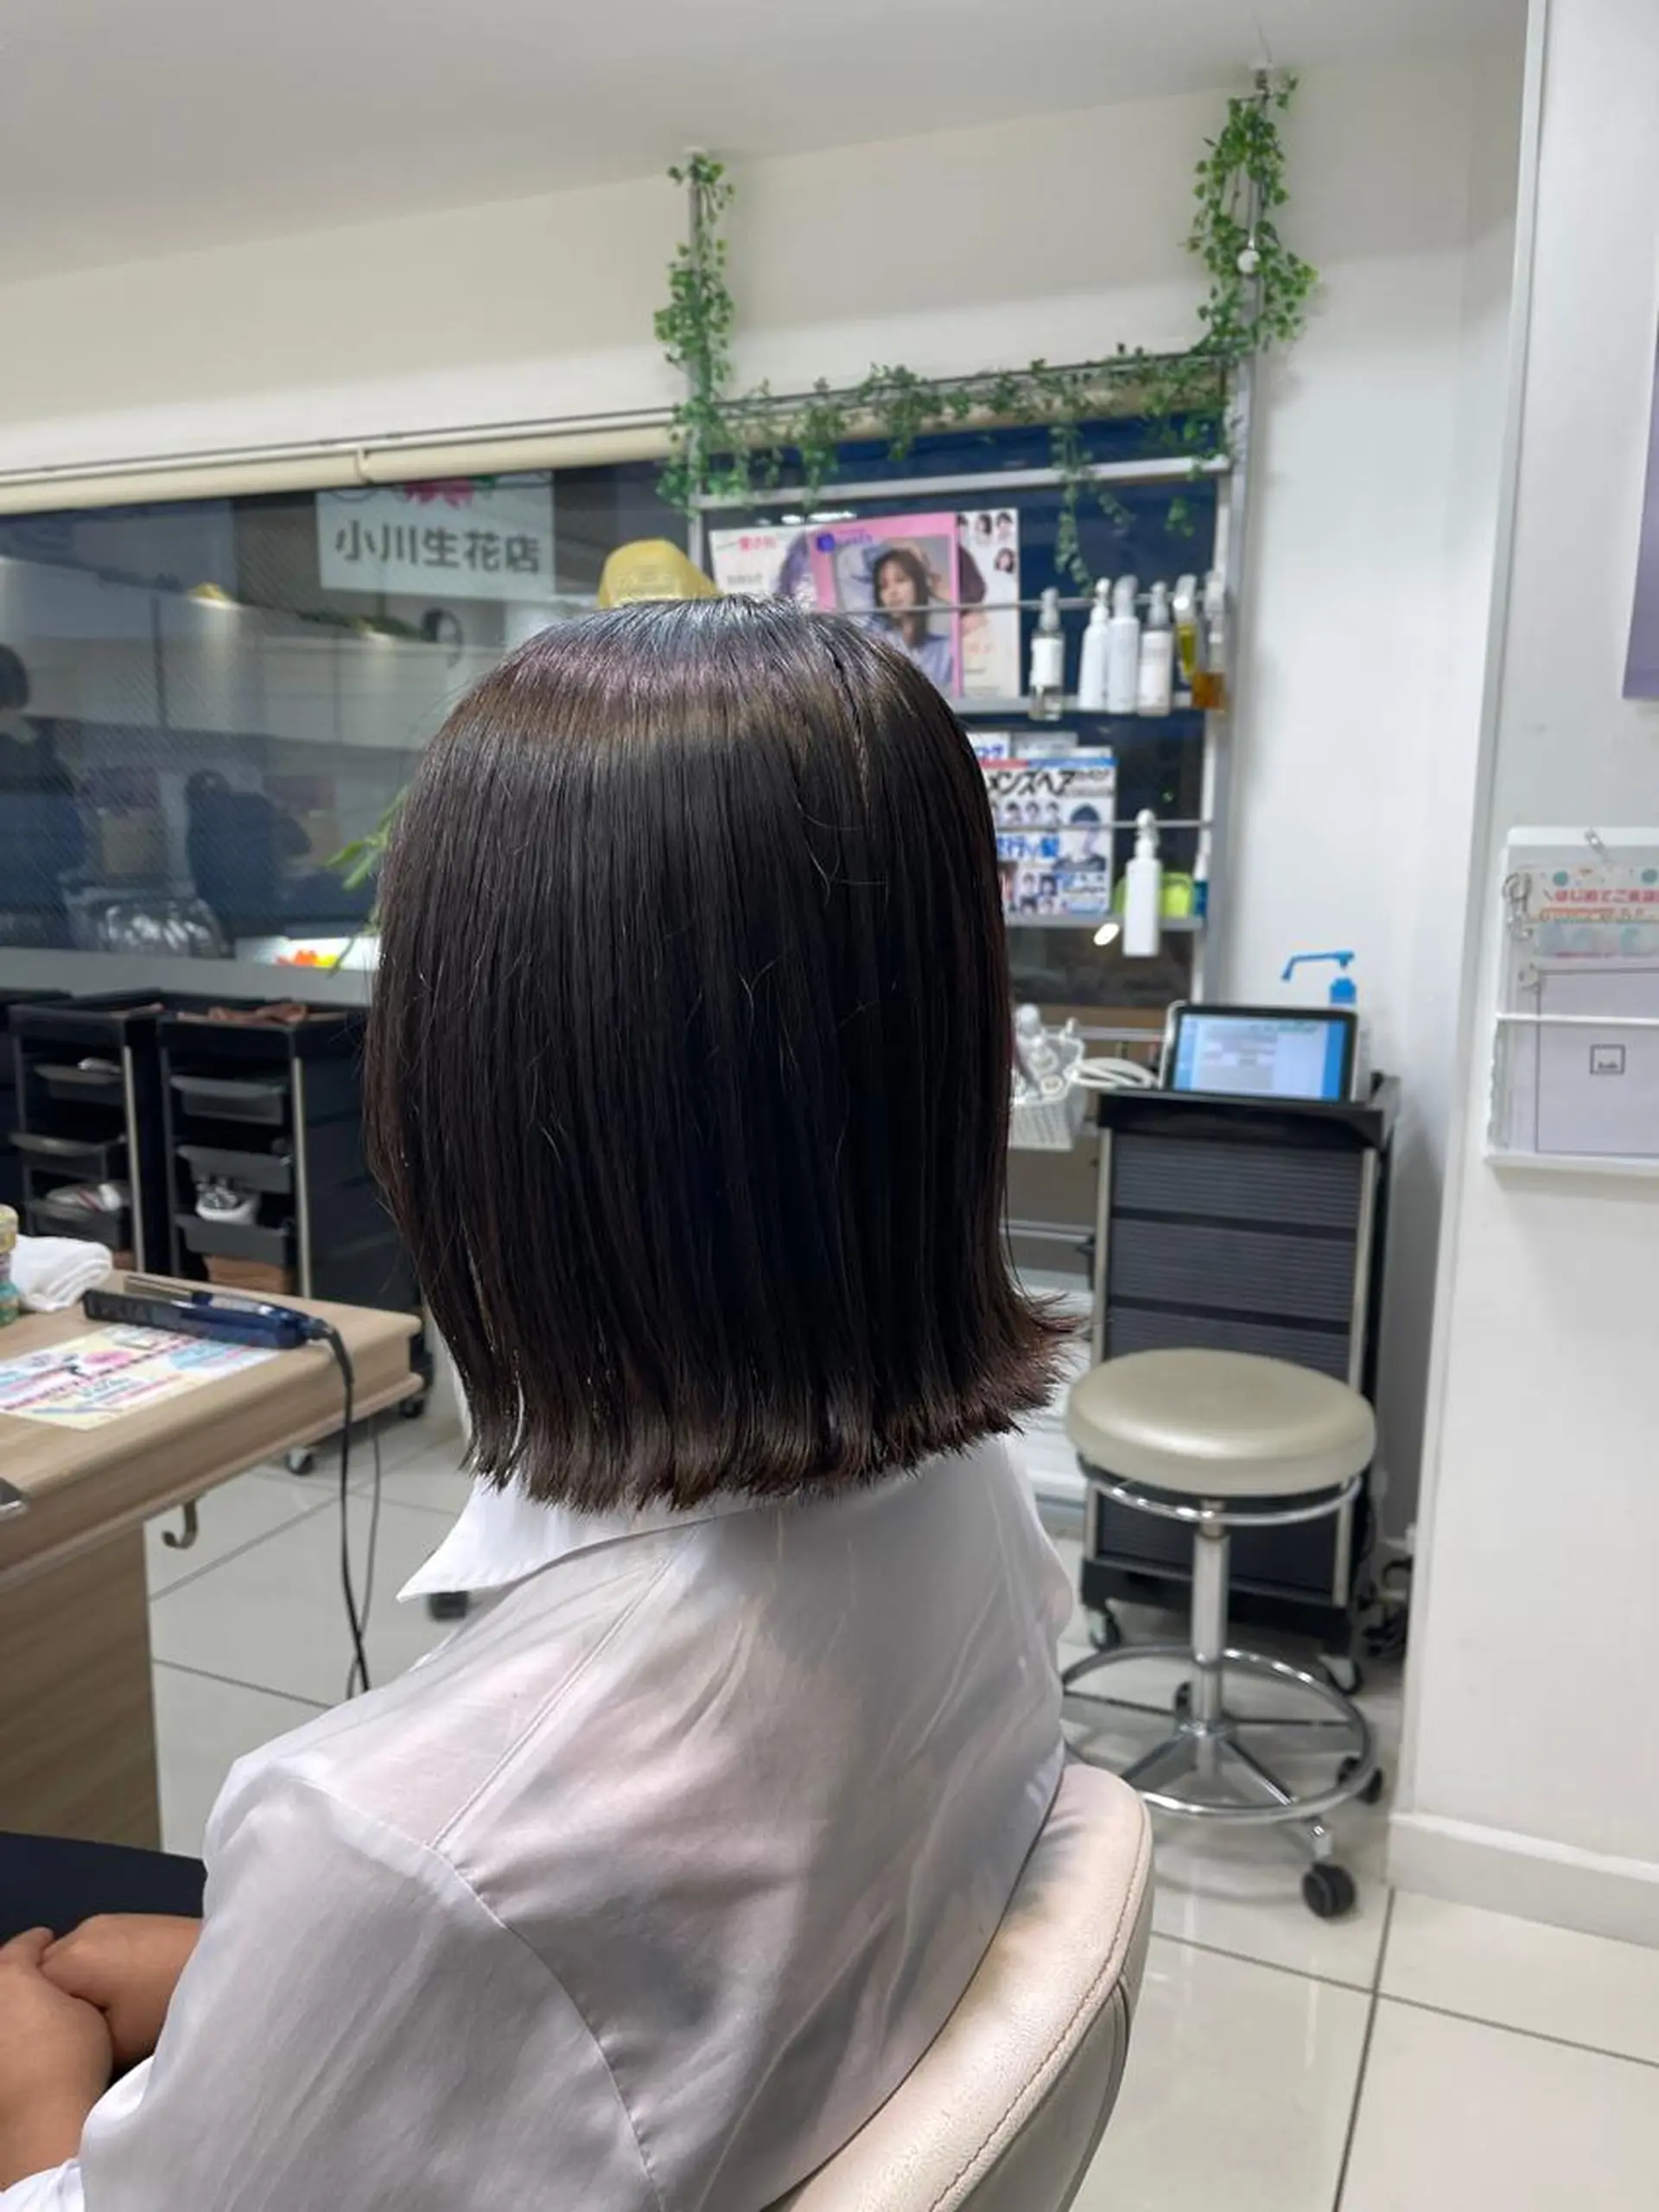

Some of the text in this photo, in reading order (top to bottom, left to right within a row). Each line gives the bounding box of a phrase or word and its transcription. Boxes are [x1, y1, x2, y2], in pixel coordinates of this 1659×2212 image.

[334, 519, 541, 574] 小川生花店
